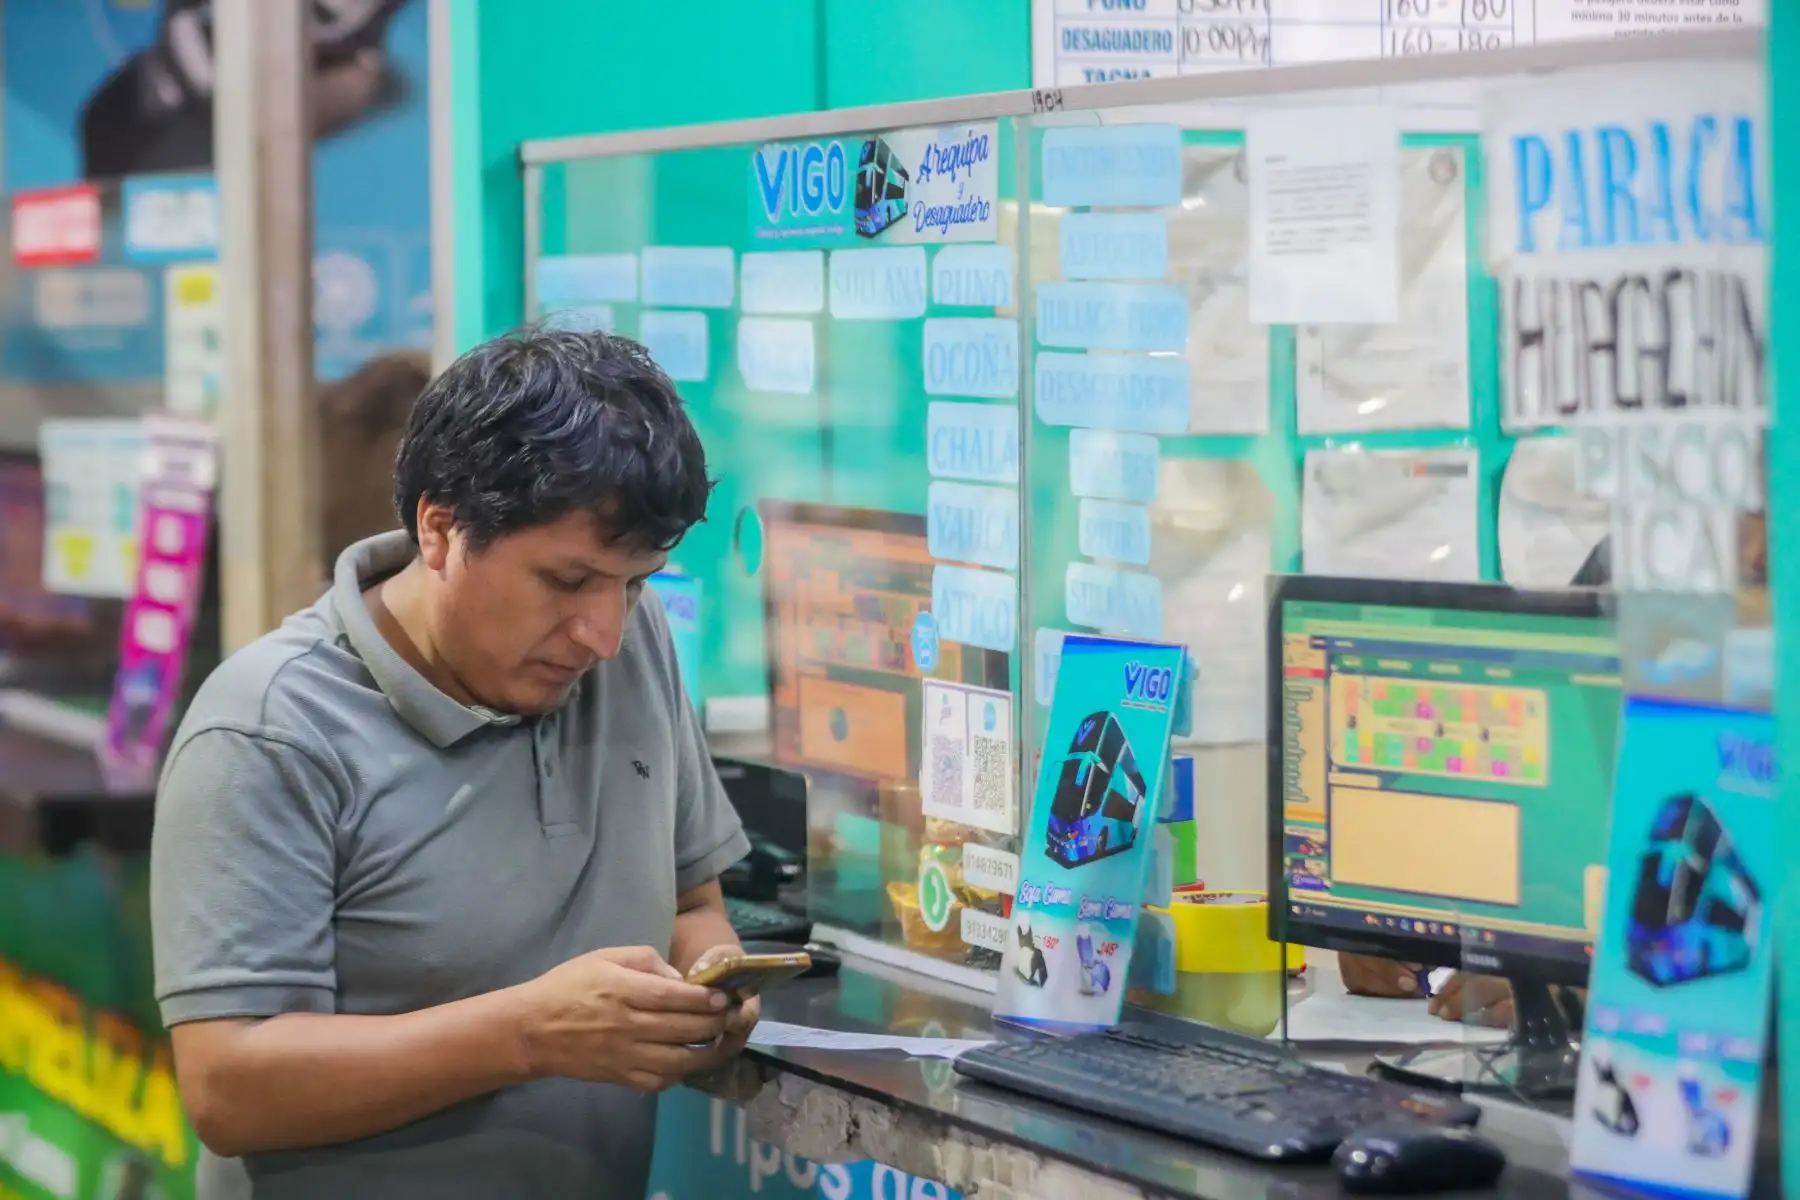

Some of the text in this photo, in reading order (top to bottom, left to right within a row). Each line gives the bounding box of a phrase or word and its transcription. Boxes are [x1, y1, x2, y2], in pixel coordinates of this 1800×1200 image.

[1062, 27, 1173, 52] DESAGUADERO
[915, 130, 989, 185] Arequipa
[755, 140, 847, 224] VIGO
[913, 194, 990, 236] Desaguadero
[933, 425, 1017, 472] CHALA
[1124, 660, 1172, 702] VIGO
